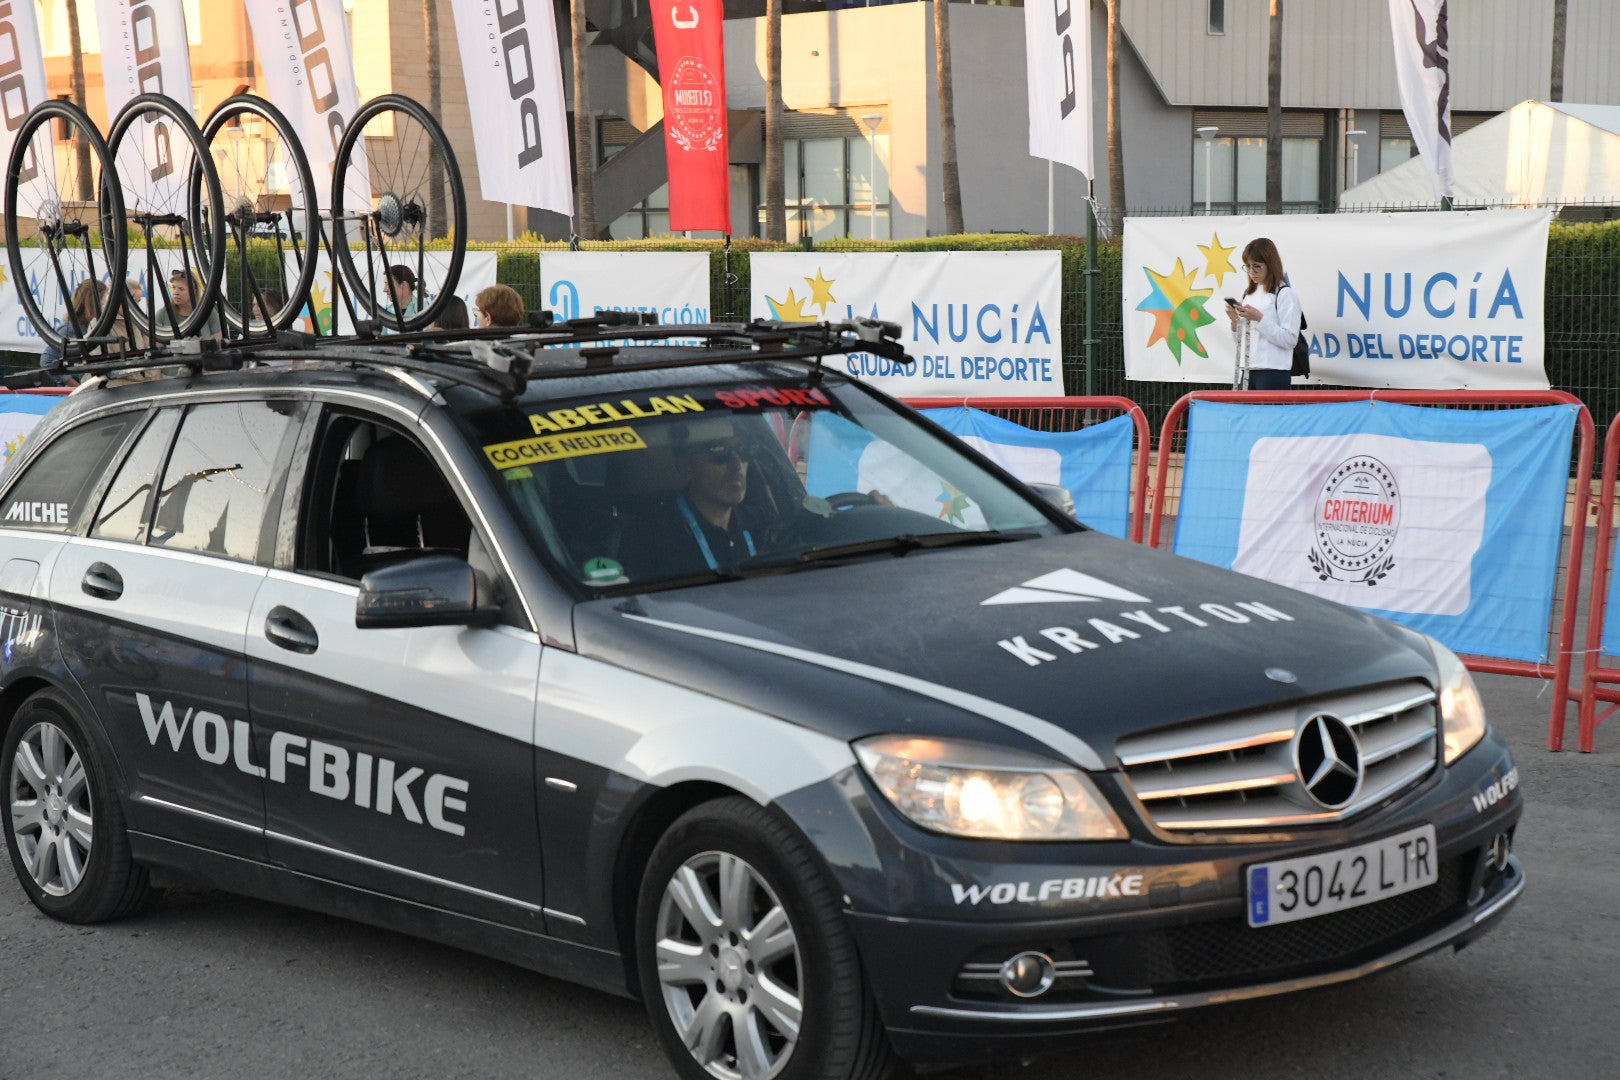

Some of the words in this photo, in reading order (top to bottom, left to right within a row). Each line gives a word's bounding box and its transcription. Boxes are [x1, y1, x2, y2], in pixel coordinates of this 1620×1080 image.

[1347, 333, 1394, 359] DEL
[1399, 334, 1524, 363] DEPORTE
[846, 352, 917, 377] CIUDAD
[922, 355, 956, 379] DEL
[960, 356, 1053, 382] DEPORTE
[528, 394, 705, 435] ABELLAN
[490, 442, 559, 464] COCHE
[560, 432, 638, 452] NEUTRO
[4, 501, 69, 524] MICHE
[1324, 499, 1393, 526] CRITERIUM
[997, 600, 1296, 667] KRAYTON
[135, 692, 470, 837] WOLFBIKE
[951, 874, 1144, 906] WOLFBIKE
[1279, 855, 1369, 912] 3042
[1379, 836, 1431, 891] LTR
